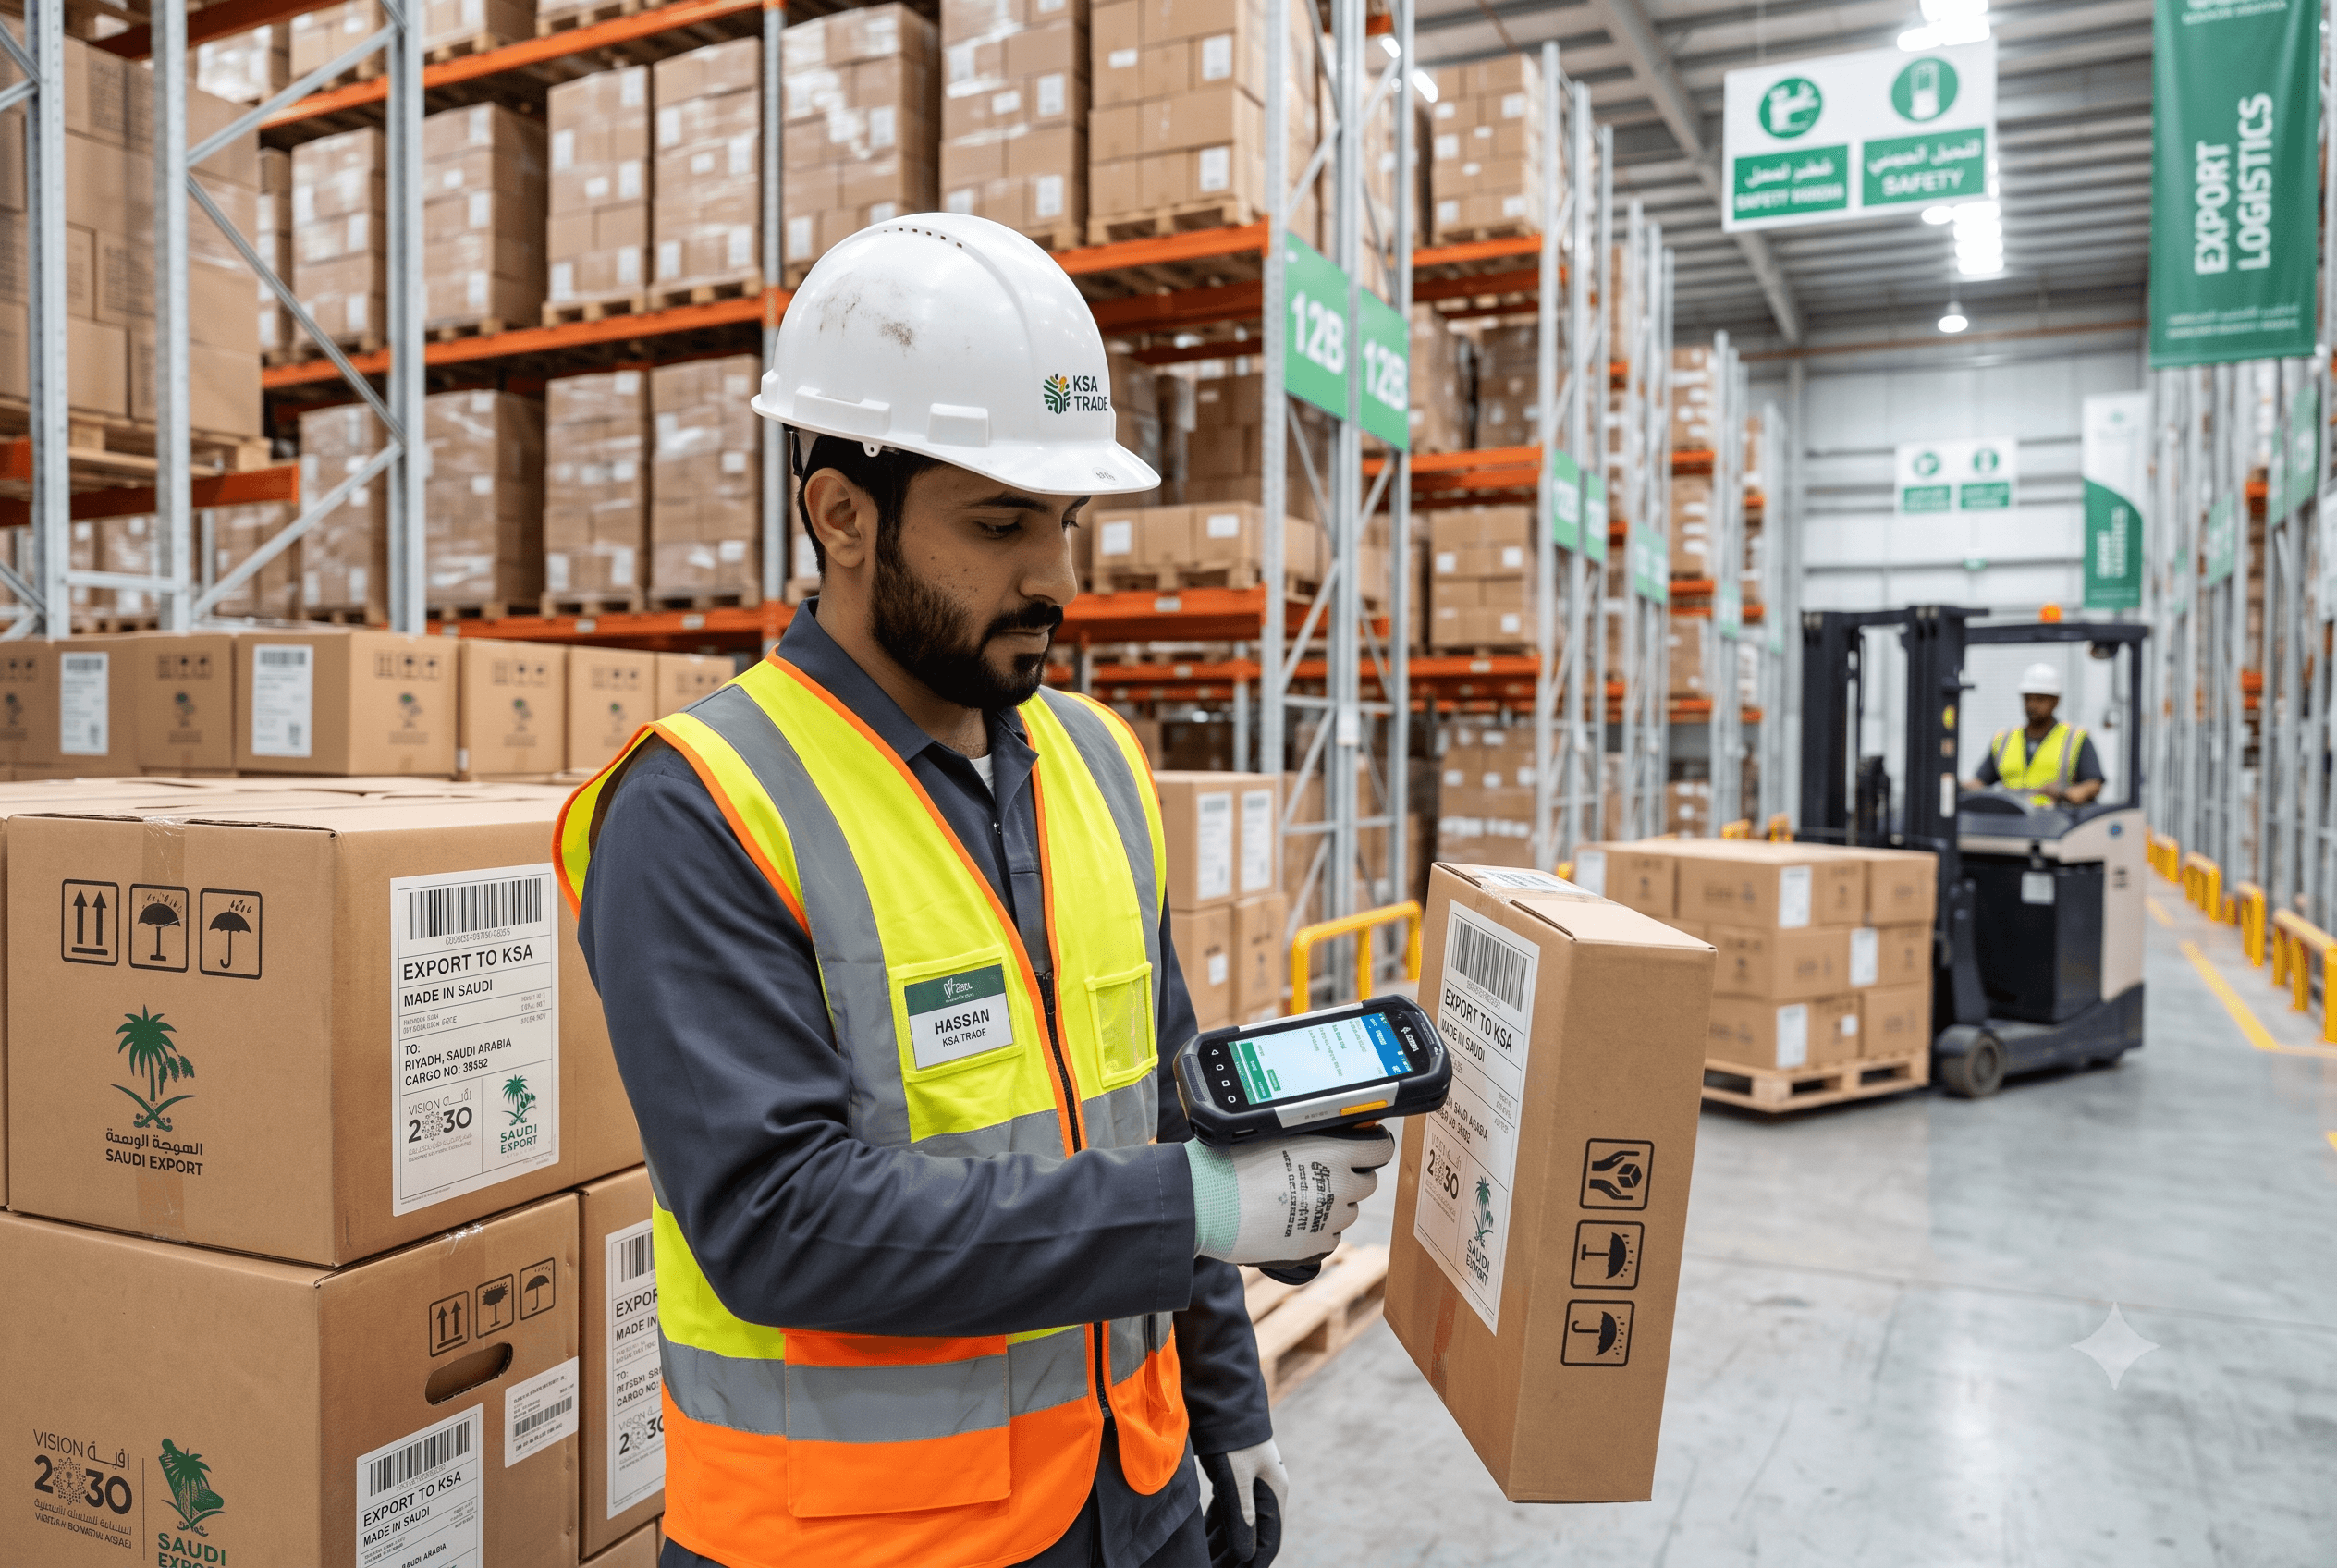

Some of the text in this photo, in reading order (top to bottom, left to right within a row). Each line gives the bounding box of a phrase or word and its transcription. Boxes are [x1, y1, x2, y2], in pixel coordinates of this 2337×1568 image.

[2236, 93, 2273, 271] LOGISTICS
[2195, 140, 2231, 275] EXPORT
[1291, 291, 1346, 374] 12B
[1073, 375, 1098, 392] KSA
[1074, 396, 1107, 411] TRADE
[403, 944, 533, 981] EXPORT TO KSA
[404, 979, 493, 1007] MADE IN SAUDI
[935, 1008, 990, 1035] HASSAN
[1445, 988, 1478, 1026] EXPORT
[1480, 1012, 1491, 1036] TO
[1494, 1023, 1512, 1054] KSA
[404, 1043, 421, 1056] TO:
[405, 1038, 512, 1071] RIYADH, SAUDI ARABIA
[943, 1035, 960, 1047] KSA
[1441, 1019, 1485, 1062] MADE IN SAUDI
[405, 1069, 441, 1086] CARGO
[444, 1065, 461, 1078] NO:
[409, 1098, 440, 1116] VISION
[500, 1123, 537, 1143] SAUDI
[500, 1135, 538, 1154] EXPORT
[106, 1148, 203, 1176] SAUDI EXPORT
[616, 1288, 657, 1317] EXPOR
[616, 1315, 656, 1341] MADE IN
[617, 1371, 628, 1381] TO:
[33, 1429, 83, 1457] VISION
[363, 1493, 415, 1527] EXPORT
[419, 1484, 434, 1501] TO
[438, 1471, 461, 1491] KSA
[363, 1526, 389, 1547] MADE
[393, 1520, 400, 1533] IN
[404, 1506, 430, 1526] SAUDI
[158, 1533, 226, 1566] SAUDI
